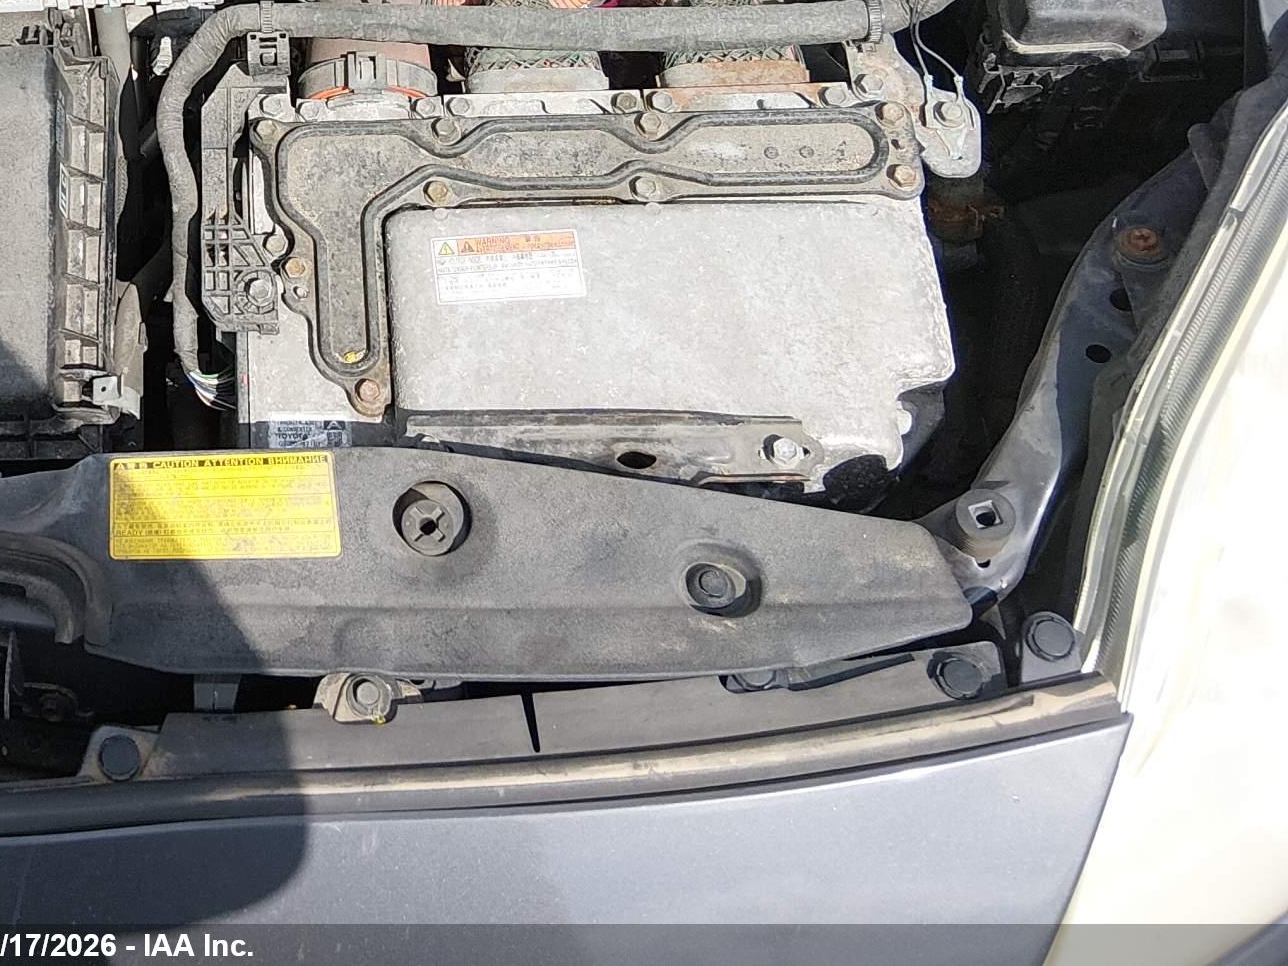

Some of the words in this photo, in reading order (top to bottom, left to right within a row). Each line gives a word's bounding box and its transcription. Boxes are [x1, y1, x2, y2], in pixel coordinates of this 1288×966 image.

[153, 458, 199, 468] CAUTION
[204, 456, 263, 467] ATTENTION
[269, 454, 326, 465] ВНИМАНИЕ
